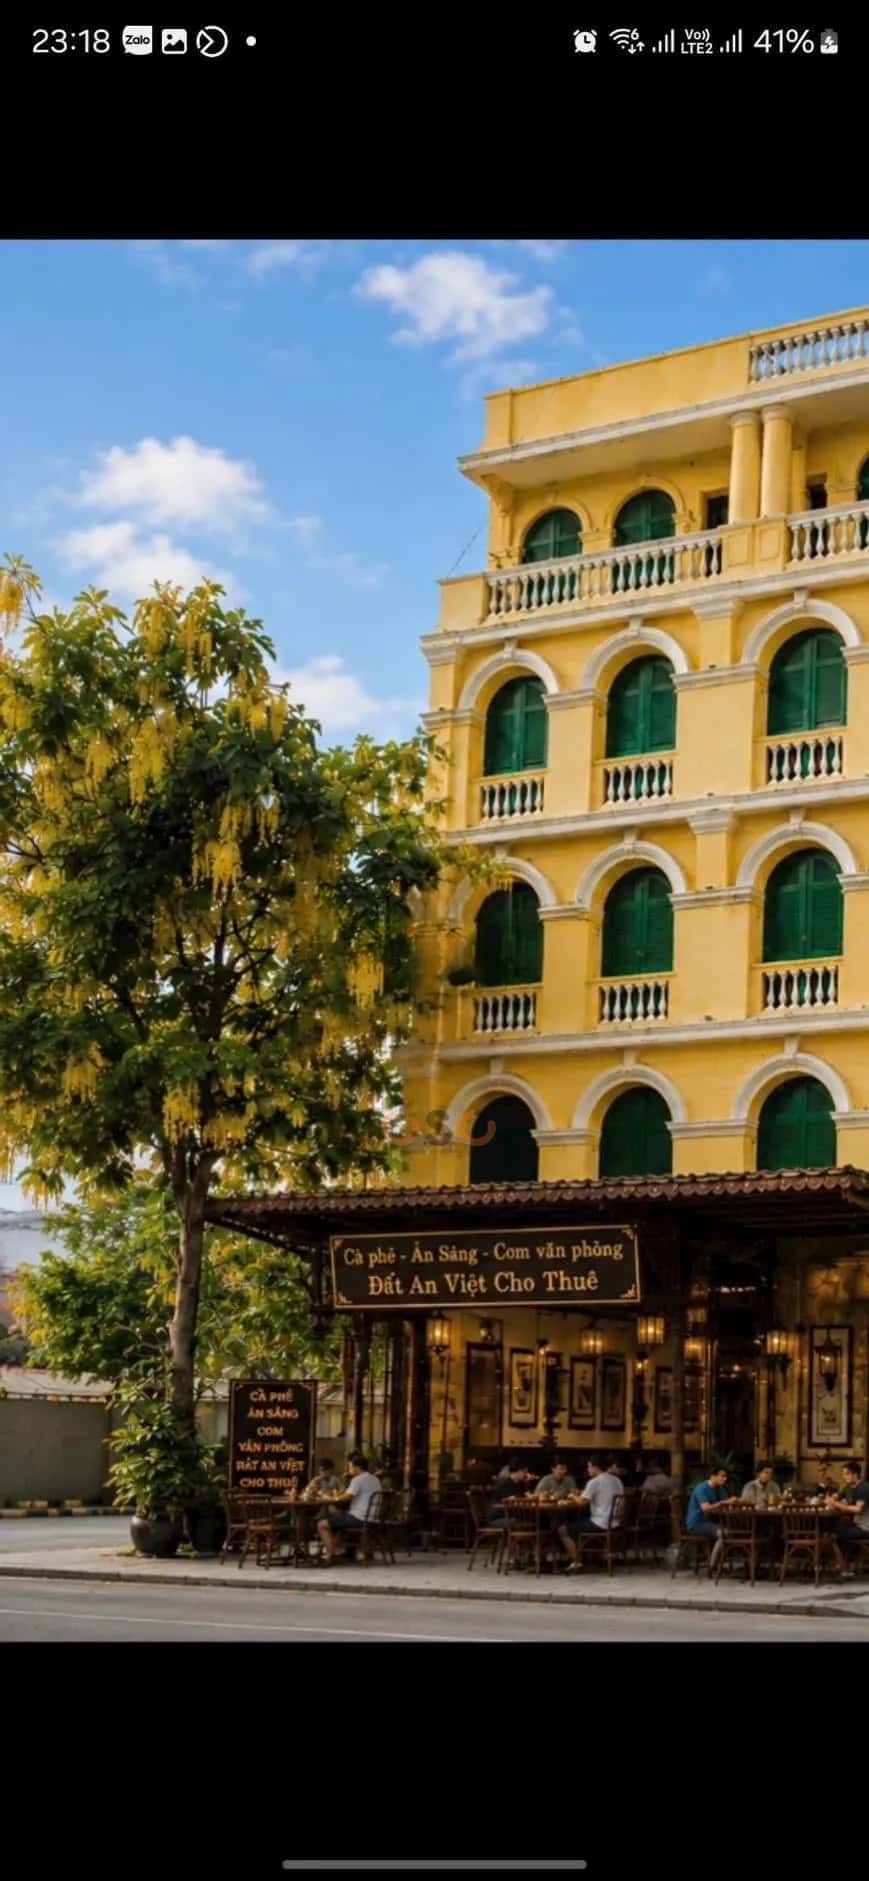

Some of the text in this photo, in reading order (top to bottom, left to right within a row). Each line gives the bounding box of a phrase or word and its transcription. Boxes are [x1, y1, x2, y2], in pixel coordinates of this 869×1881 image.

[367, 1269, 600, 1297] Đất An Việt Cho Thuê
